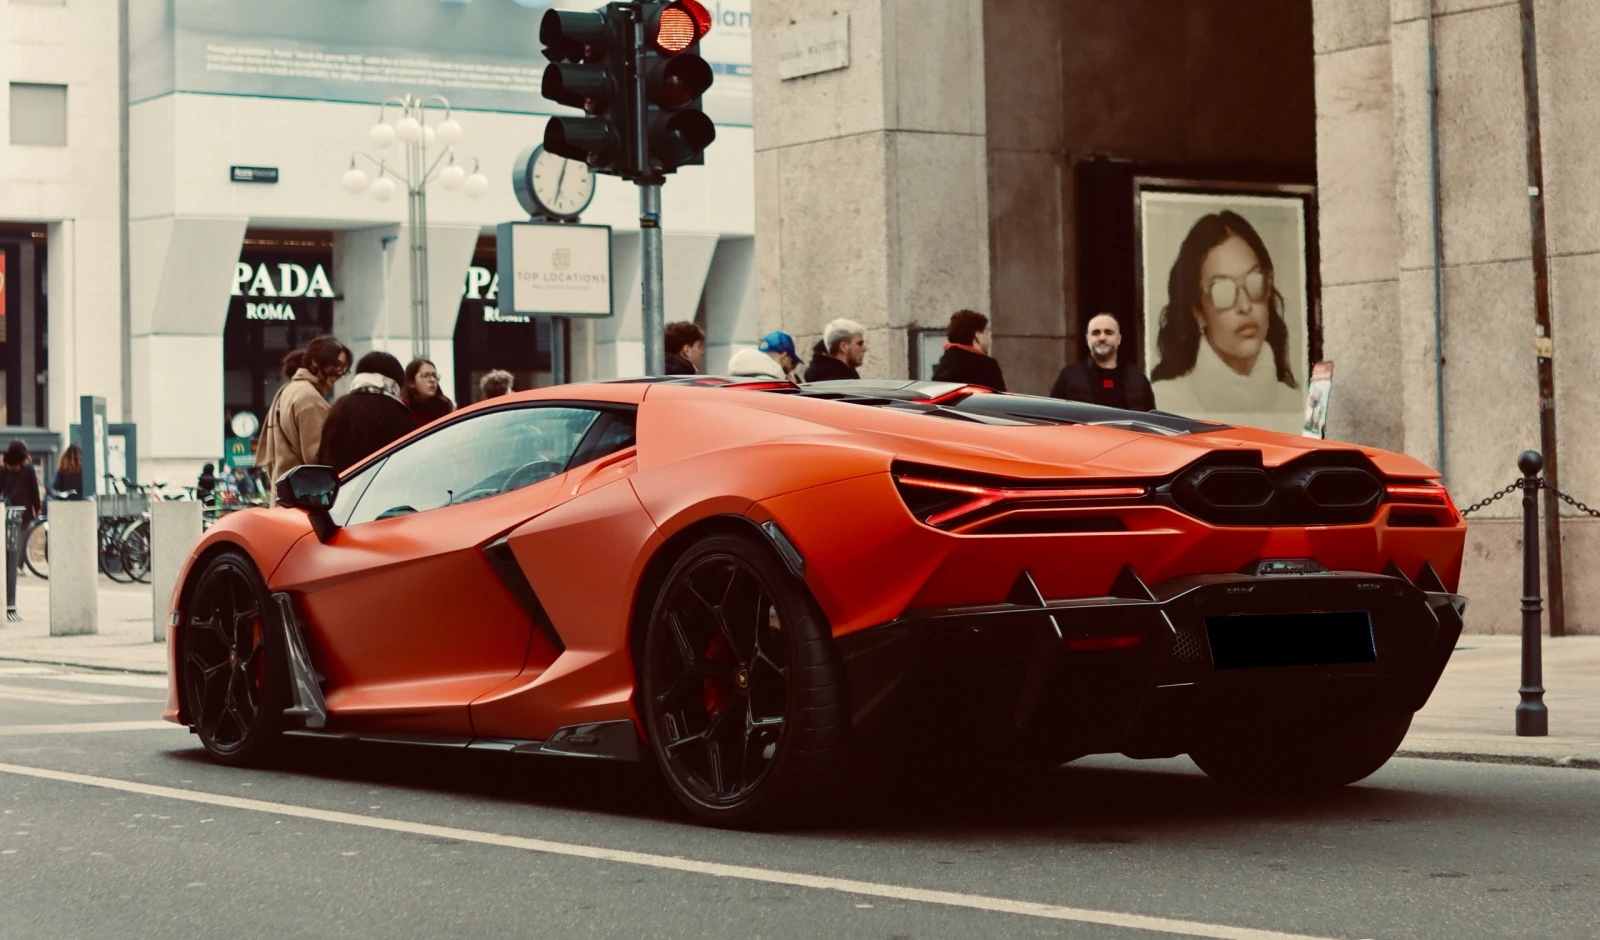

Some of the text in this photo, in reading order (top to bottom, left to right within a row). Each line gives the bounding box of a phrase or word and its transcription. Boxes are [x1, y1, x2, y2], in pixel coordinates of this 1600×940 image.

[516, 271, 607, 284] TOP LOCATIONS
[246, 302, 296, 320] ROMA
